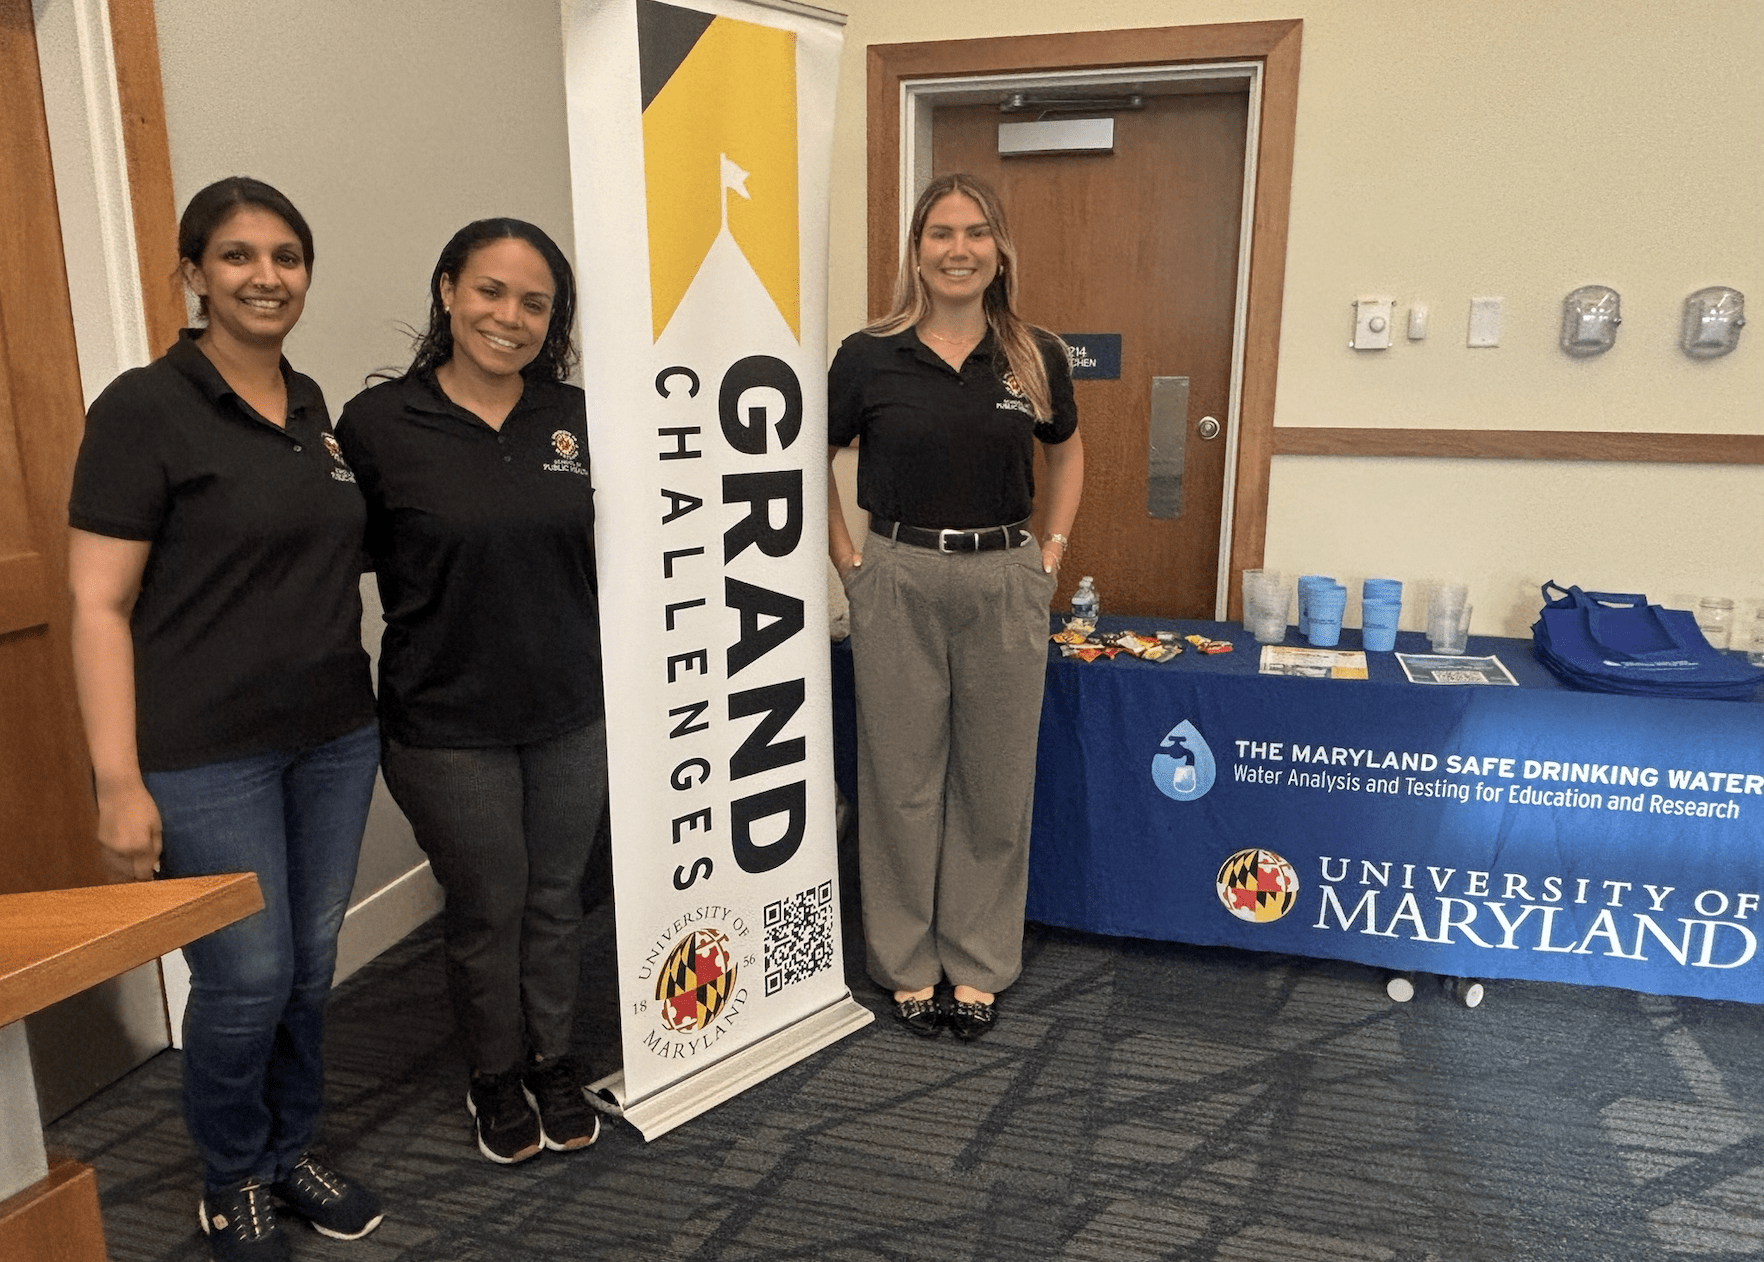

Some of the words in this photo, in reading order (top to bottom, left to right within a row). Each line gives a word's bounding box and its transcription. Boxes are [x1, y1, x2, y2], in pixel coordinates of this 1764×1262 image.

[1071, 358, 1097, 367] CHEN
[655, 366, 714, 891] CHALLENGES
[718, 355, 806, 874] GRAND
[1234, 763, 1283, 785] Water
[1287, 768, 1360, 793] Analysis
[1365, 776, 1399, 795] and
[1405, 777, 1470, 803] Testing
[1475, 782, 1504, 803] for
[1508, 785, 1602, 809] Education
[1607, 793, 1645, 813] and
[1649, 794, 1740, 819] Research
[1235, 740, 1283, 761] THE
[1292, 744, 1438, 772] MARYLAND
[1446, 755, 1515, 778] SAFE
[1523, 760, 1659, 787] DRINKING
[1668, 769, 1764, 795] WATER
[1319, 856, 1675, 912] UNIVERSITY
[1694, 889, 1760, 919] OF
[638, 905, 732, 981] UNIVERSITY
[732, 917, 750, 938] OF
[1312, 884, 1757, 969] MARYLAND
[632, 1000, 647, 1015] 18
[742, 953, 756, 968] 56
[642, 988, 748, 1060] MARYLAND
